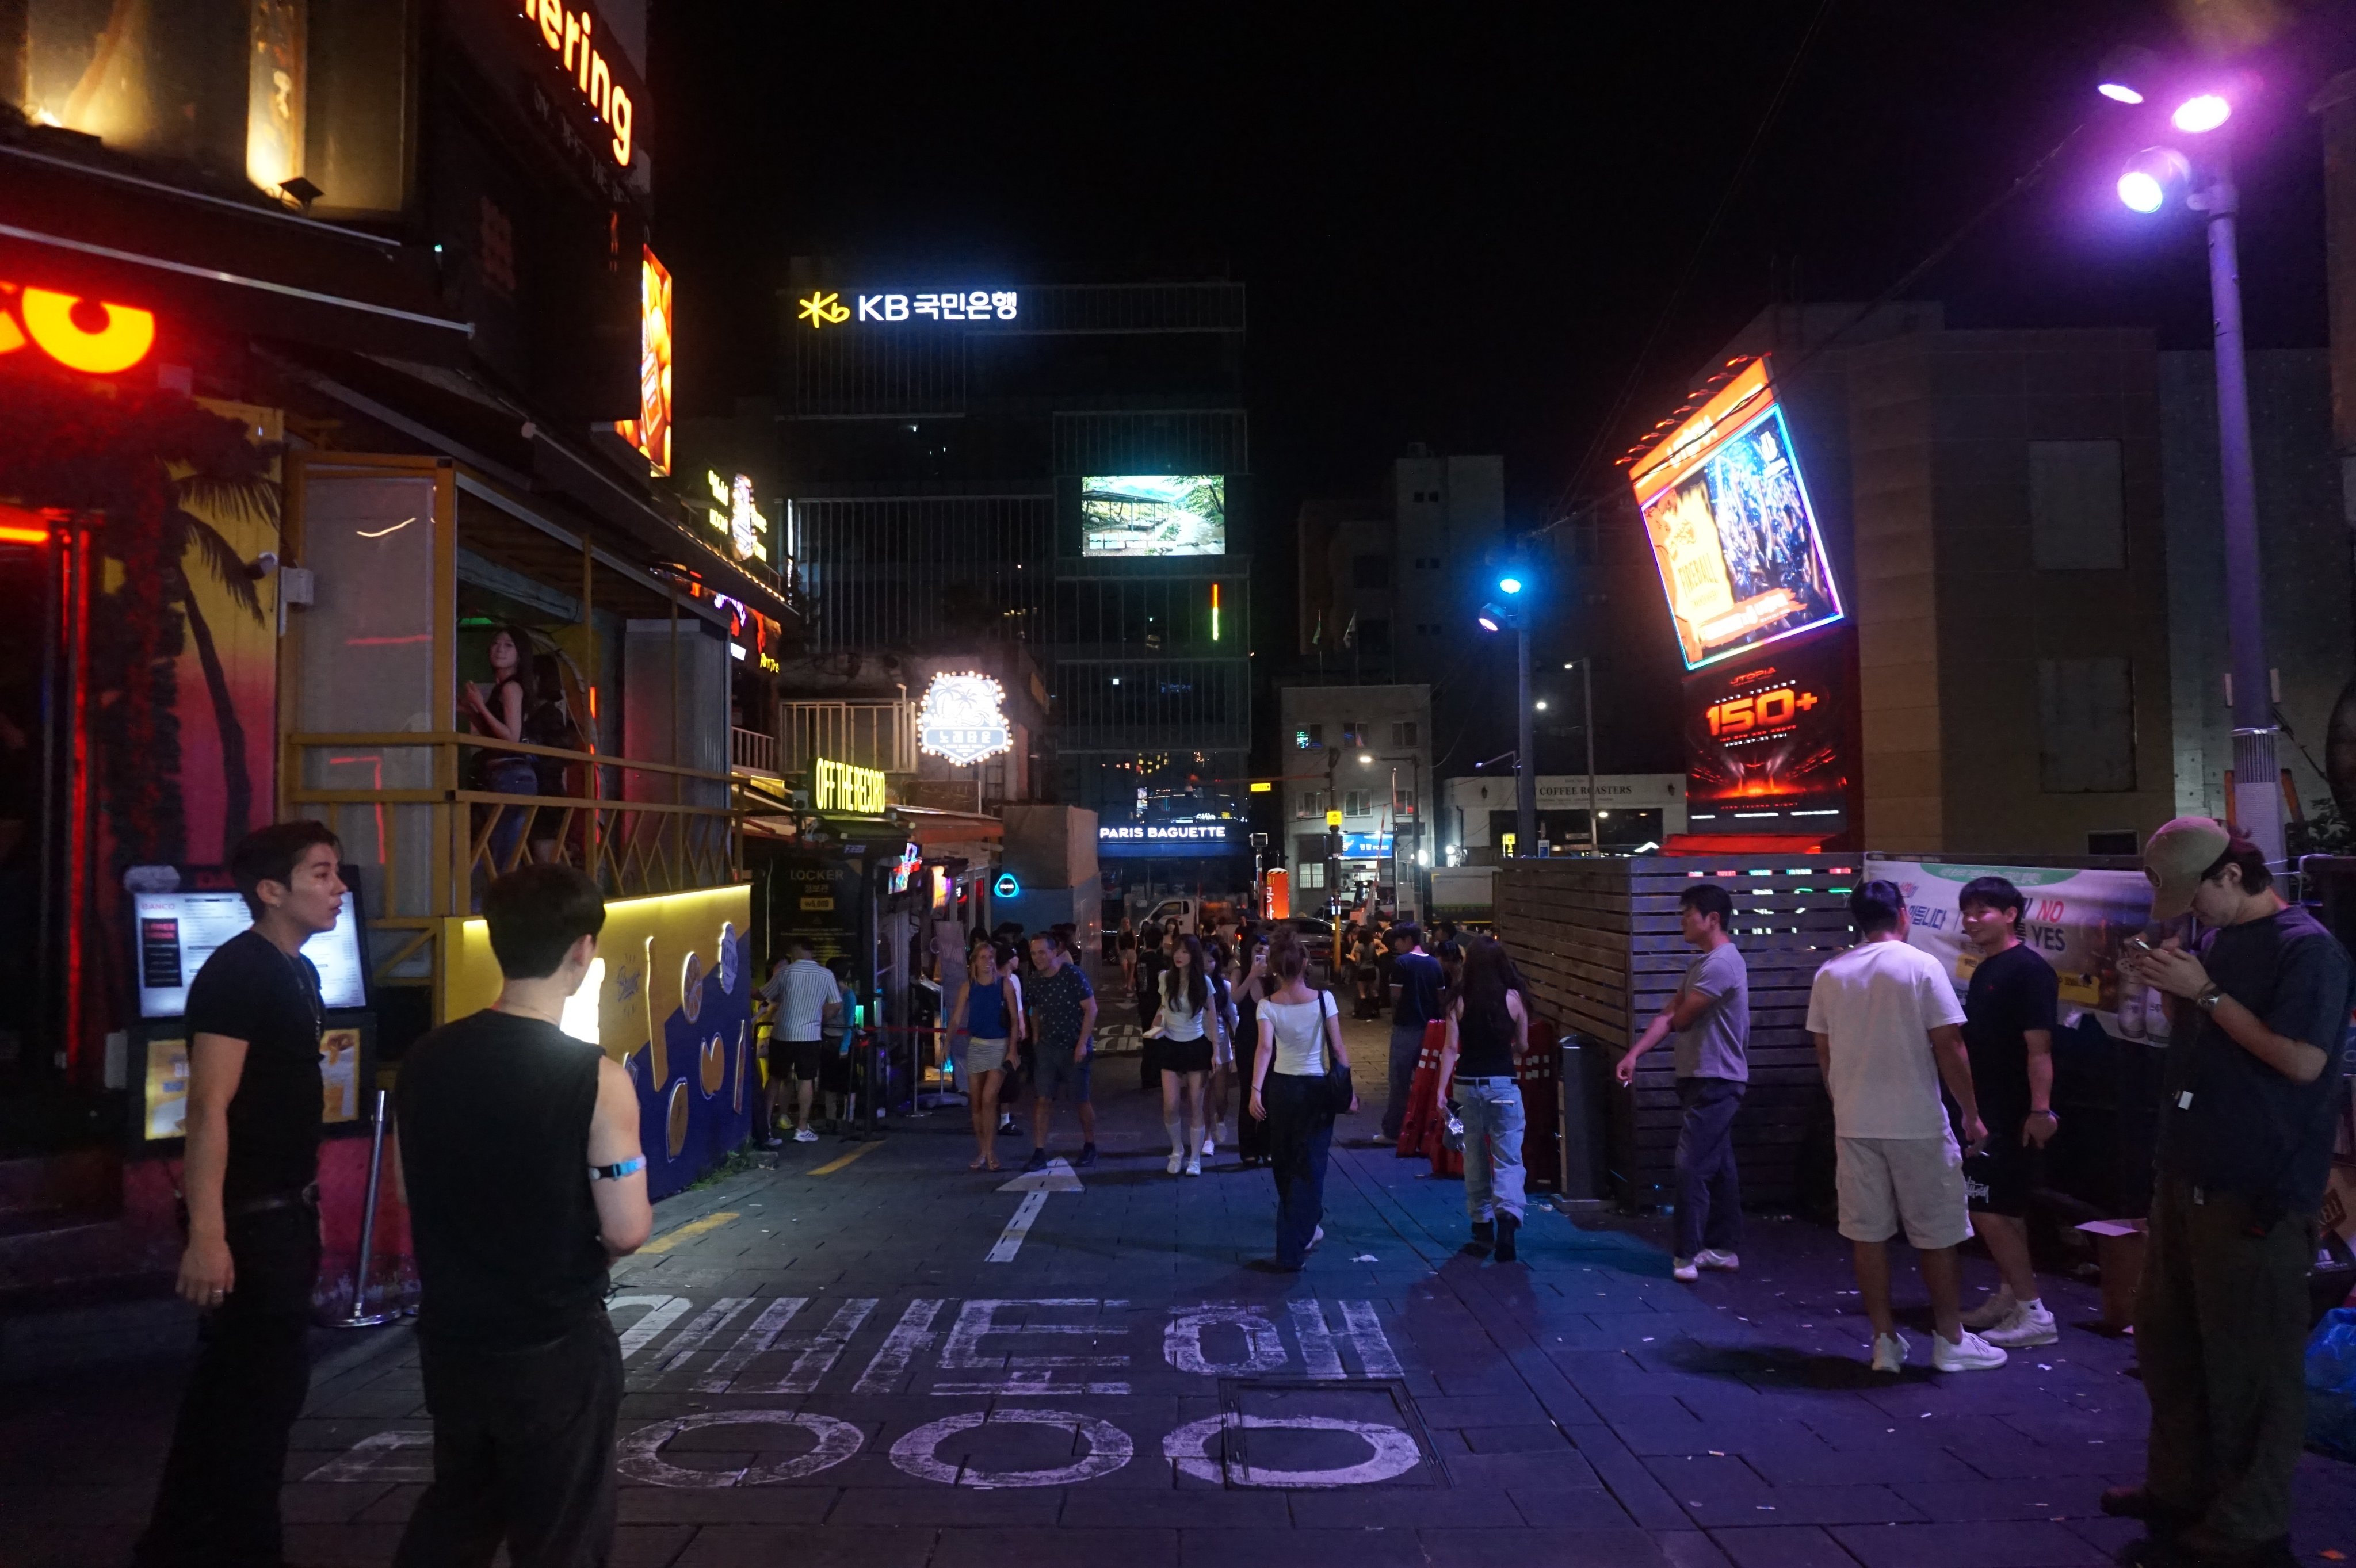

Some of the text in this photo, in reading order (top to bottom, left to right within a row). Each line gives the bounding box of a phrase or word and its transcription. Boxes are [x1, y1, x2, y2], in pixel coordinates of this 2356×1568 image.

[526, 0, 632, 166] ering
[859, 291, 1018, 321] KB 국민은행
[1729, 667, 1777, 684] UTOPIA
[1706, 689, 1818, 736] 150+
[939, 731, 991, 744] 노래타운
[816, 758, 885, 813] OFF THE RECORD
[1540, 786, 1578, 796] COFFEE
[1099, 827, 1225, 839] PARIS BAGUETTE
[790, 869, 844, 881] LOCKER
[2036, 900, 2064, 923] NO
[2032, 925, 2066, 951] YES
